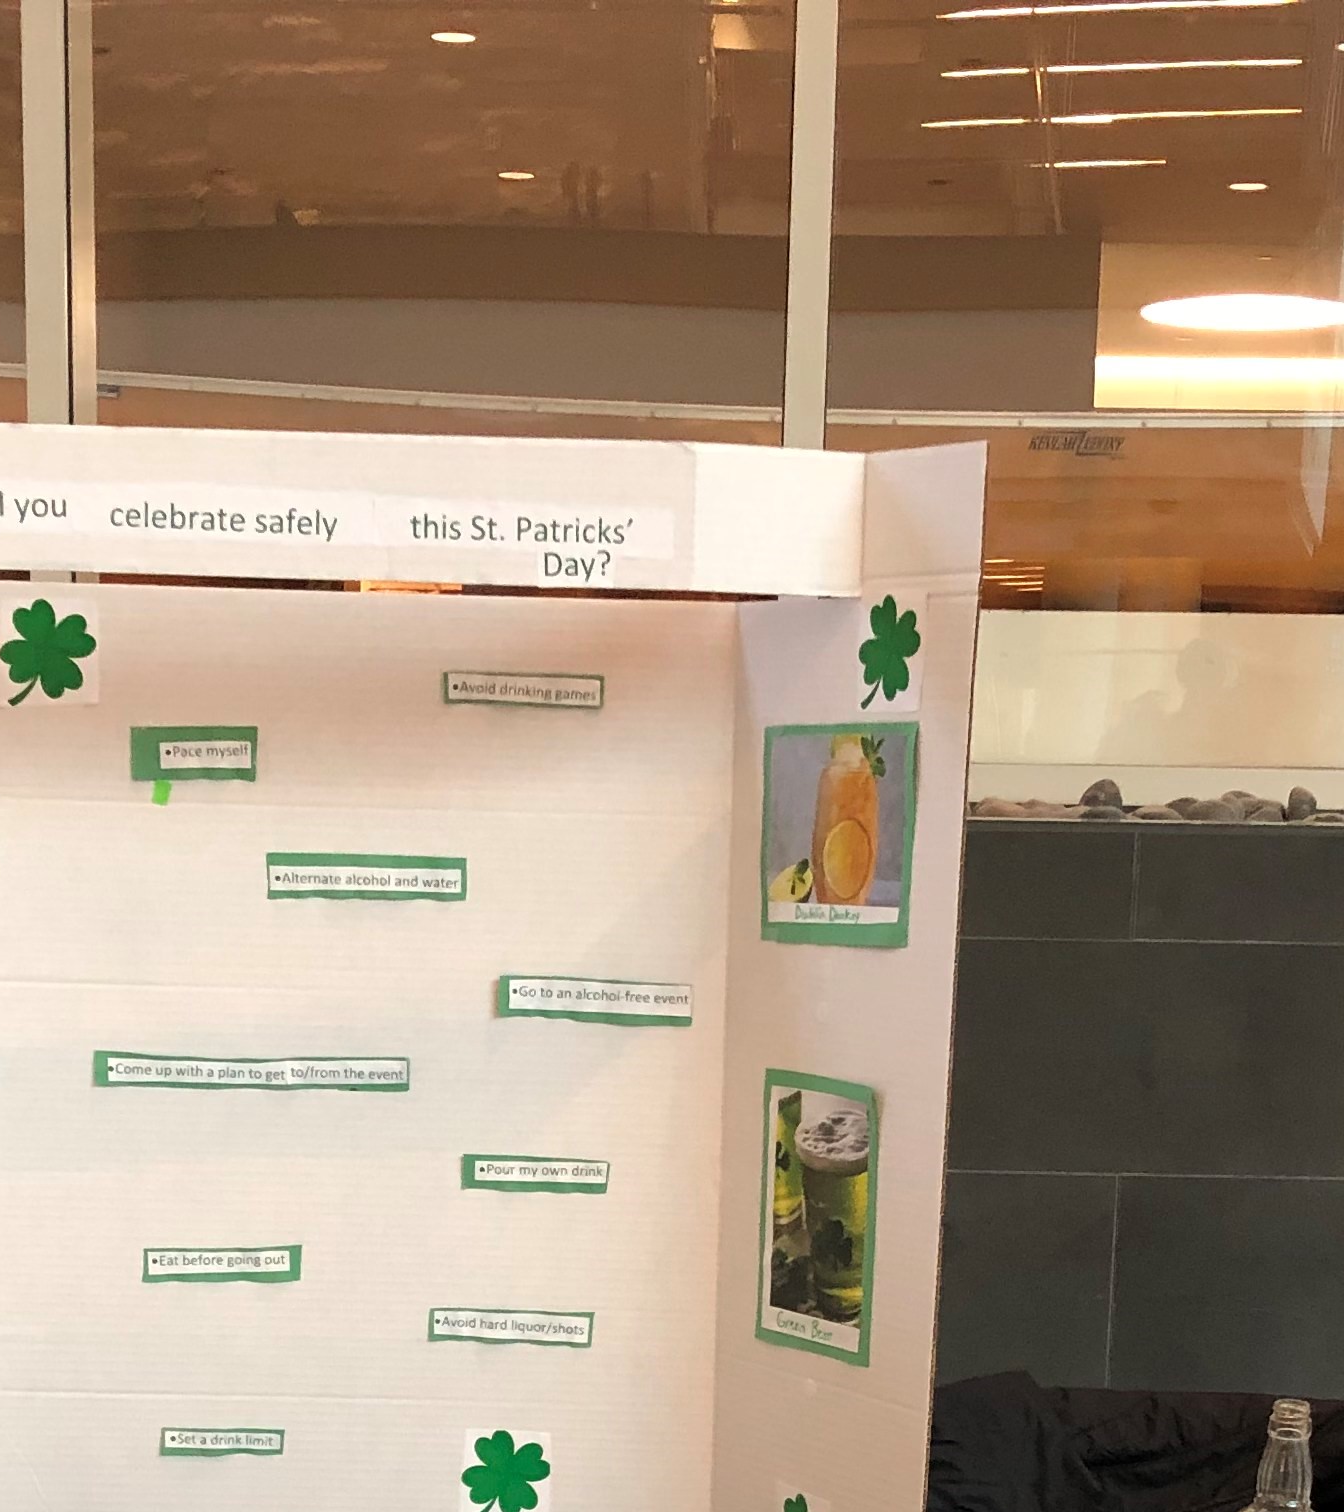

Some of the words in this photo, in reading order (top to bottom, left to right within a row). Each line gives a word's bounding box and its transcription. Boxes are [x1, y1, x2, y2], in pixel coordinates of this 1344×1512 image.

[14, 496, 67, 523] you
[109, 501, 247, 534] celebrate
[254, 507, 338, 542] safely
[410, 514, 462, 541] this
[471, 515, 506, 542] St.
[543, 550, 612, 582] Day?
[459, 681, 496, 696] Avoid
[499, 682, 552, 701] drinking
[555, 689, 597, 702] games
[172, 745, 203, 759] Pace
[206, 743, 249, 760] myself
[282, 871, 342, 886] Alternate
[345, 873, 391, 887] alcohol
[394, 875, 420, 888] and
[422, 878, 460, 890] water
[518, 985, 537, 998] Go
[540, 987, 554, 999] to
[556, 989, 573, 1000] an
[575, 988, 651, 1004] alcohol-free
[653, 993, 690, 1006] event
[115, 1062, 153, 1076] Come
[155, 1065, 173, 1079] up
[175, 1064, 204, 1078] with
[206, 1068, 215, 1078] a
[217, 1066, 246, 1083] plan
[248, 1069, 263, 1080] to
[265, 1069, 287, 1083] get
[290, 1066, 342, 1081] to/from
[343, 1066, 366, 1080] the
[367, 1069, 405, 1082] event
[486, 1163, 516, 1176] Pour
[519, 1165, 539, 1179] my
[541, 1166, 569, 1177] own
[571, 1164, 604, 1178] drink
[159, 1254, 179, 1267] Eat
[182, 1253, 225, 1267] before
[227, 1254, 262, 1269] going
[264, 1254, 287, 1266] out
[441, 1316, 477, 1329] Avoid
[479, 1318, 508, 1331] hard
[511, 1319, 586, 1336] liquor/shots
[177, 1432, 197, 1445] Set
[199, 1437, 208, 1446] a
[210, 1434, 243, 1447] drink
[245, 1434, 275, 1447] limit
